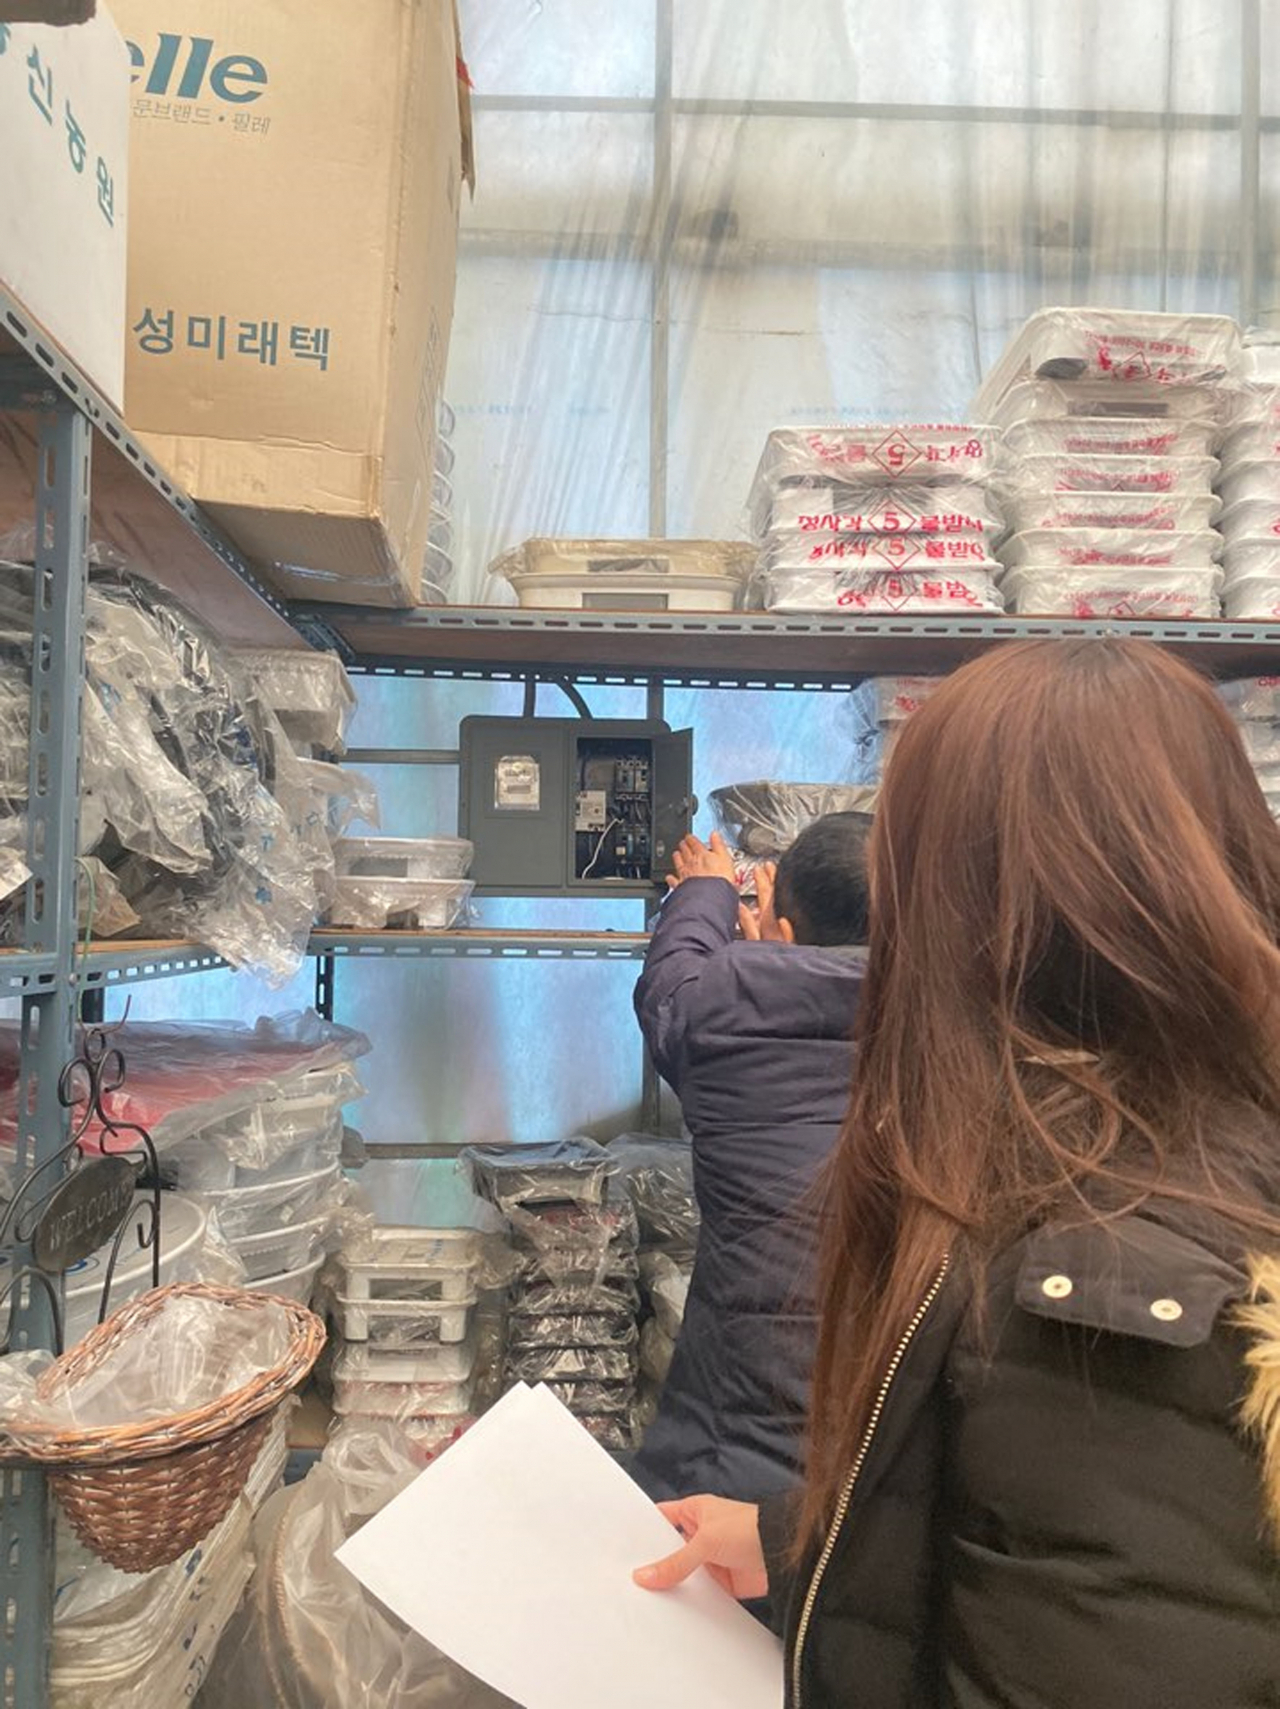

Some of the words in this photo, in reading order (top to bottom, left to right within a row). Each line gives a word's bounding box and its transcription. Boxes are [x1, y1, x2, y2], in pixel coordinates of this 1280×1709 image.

[0, 22, 113, 228] 신농원
[132, 307, 330, 371] 성미래텍
[887, 443, 906, 466] 5
[882, 511, 901, 531] 5
[887, 538, 905, 556] 5
